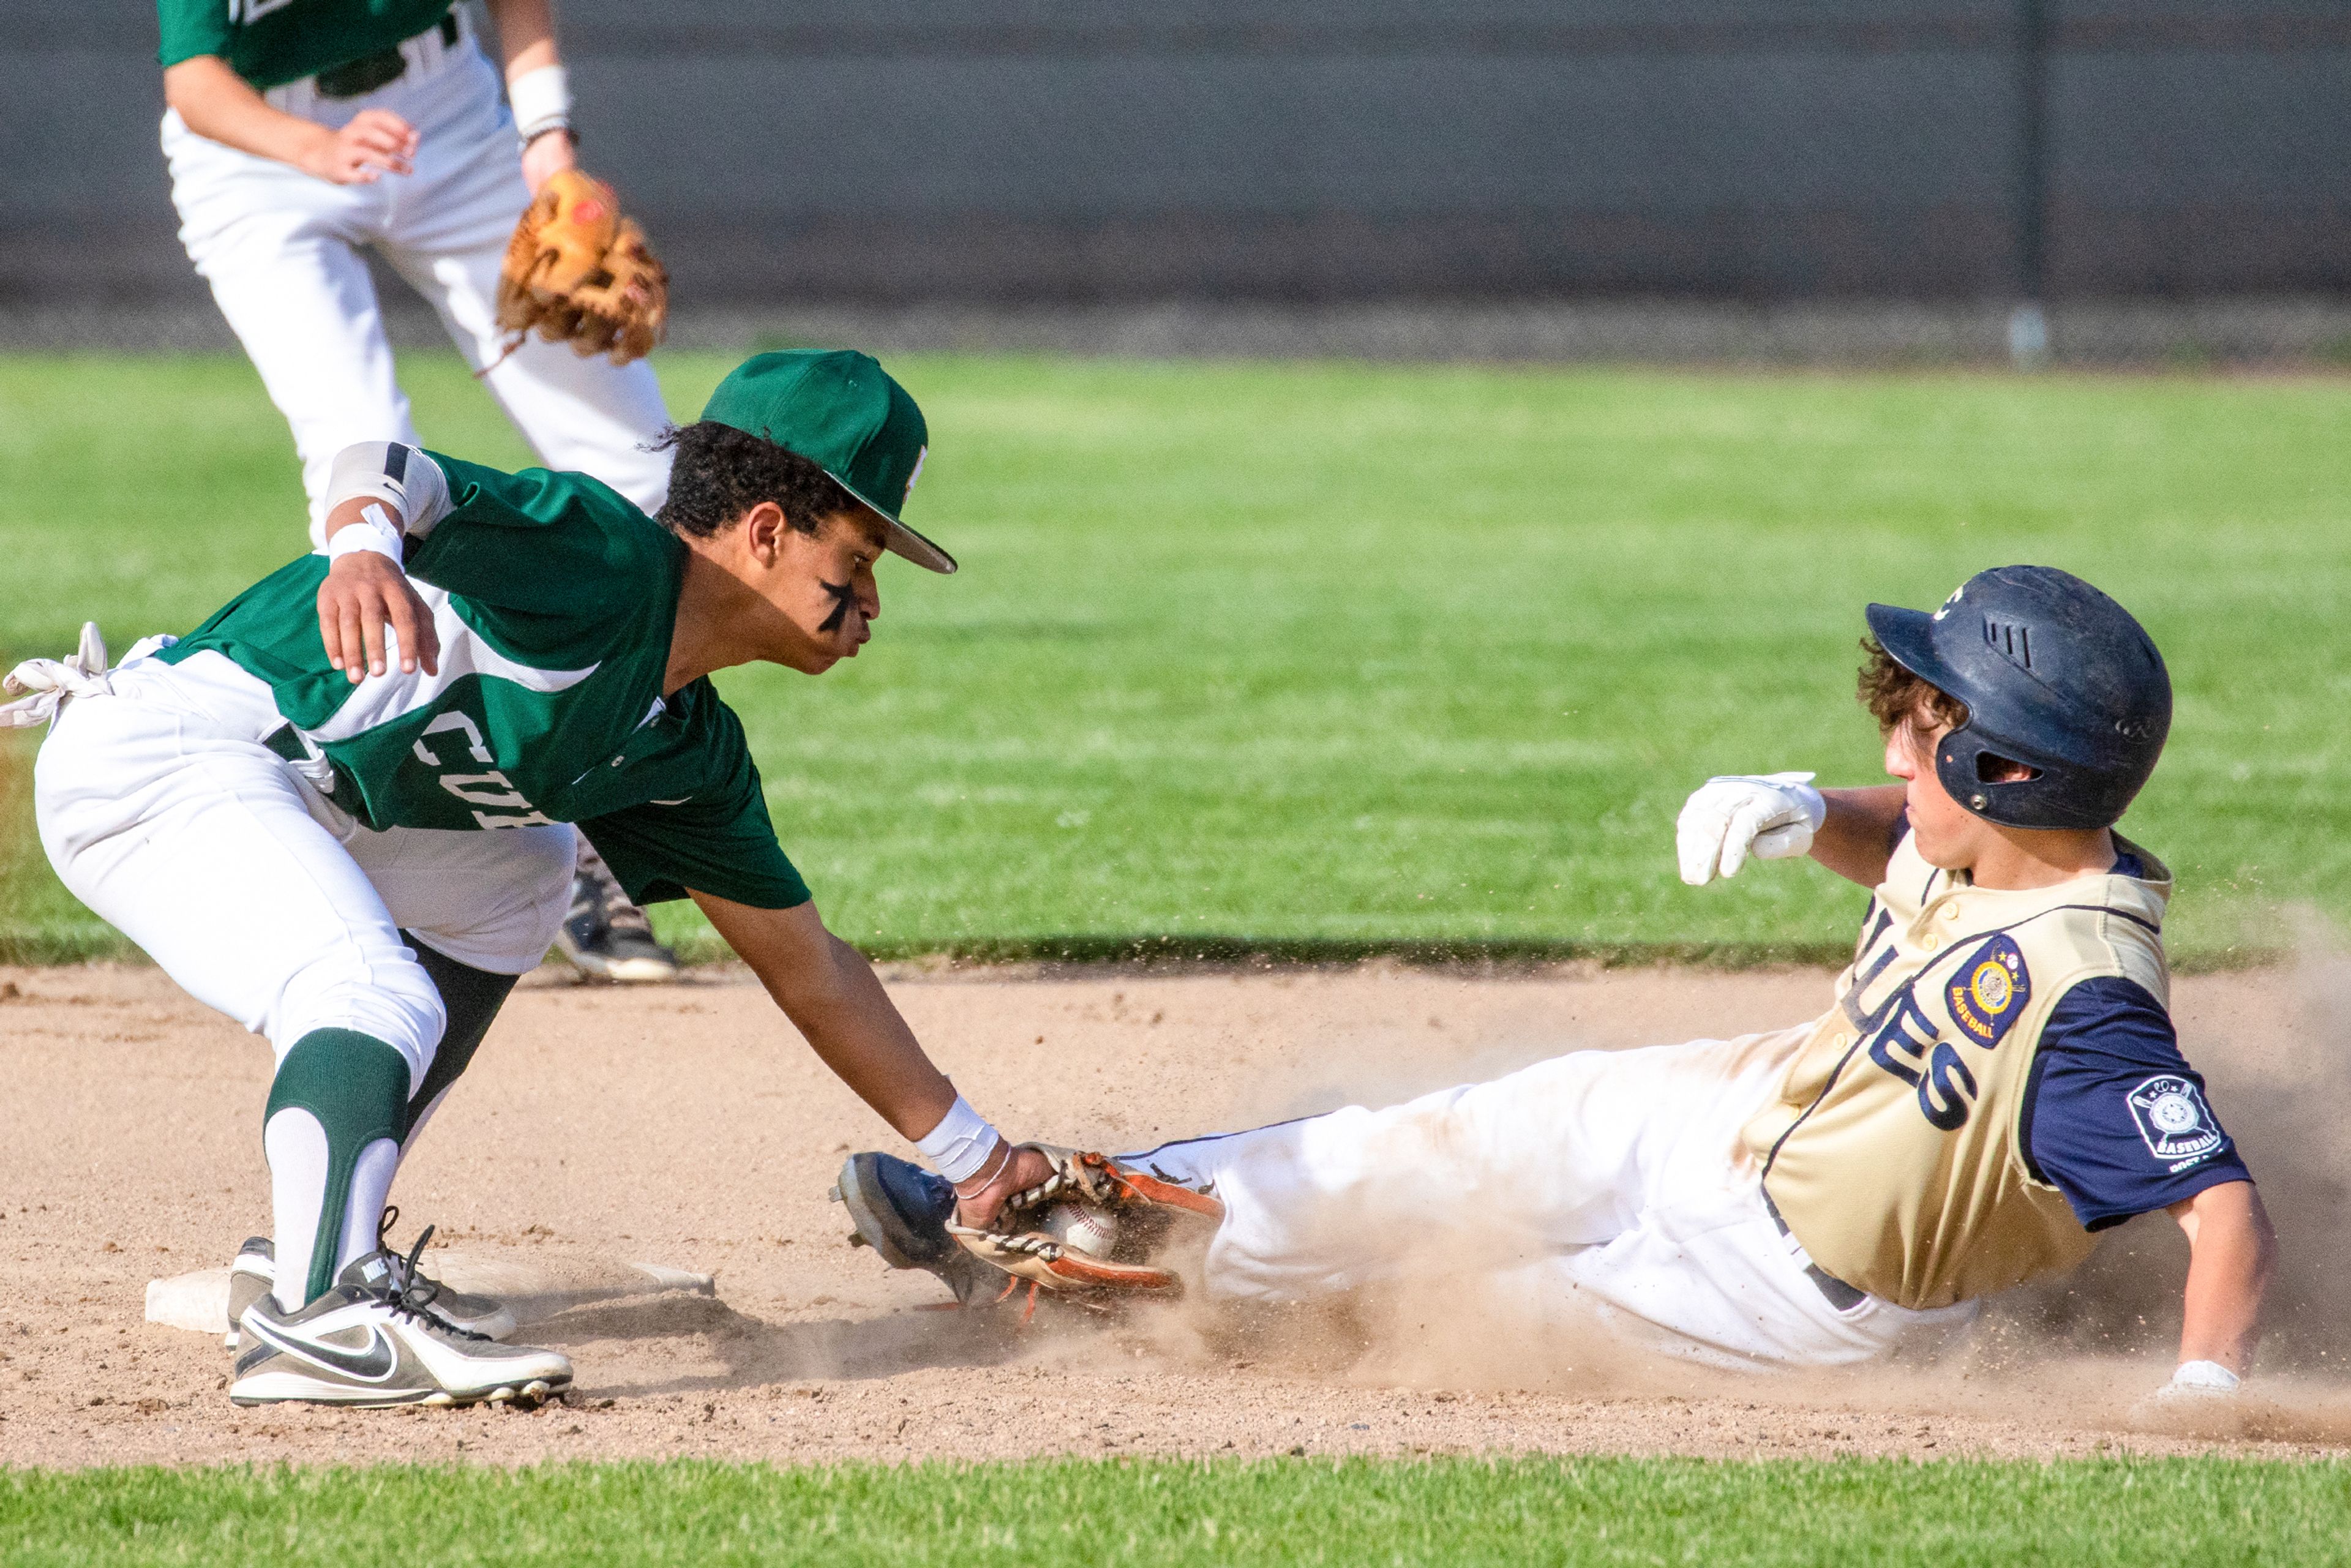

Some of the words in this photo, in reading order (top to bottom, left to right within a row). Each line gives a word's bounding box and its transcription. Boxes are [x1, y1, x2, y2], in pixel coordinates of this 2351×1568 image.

[1952, 987, 1993, 1038] BASEBALL
[2157, 1135, 2218, 1154] BASEBALL
[361, 1257, 388, 1283] NIKE
